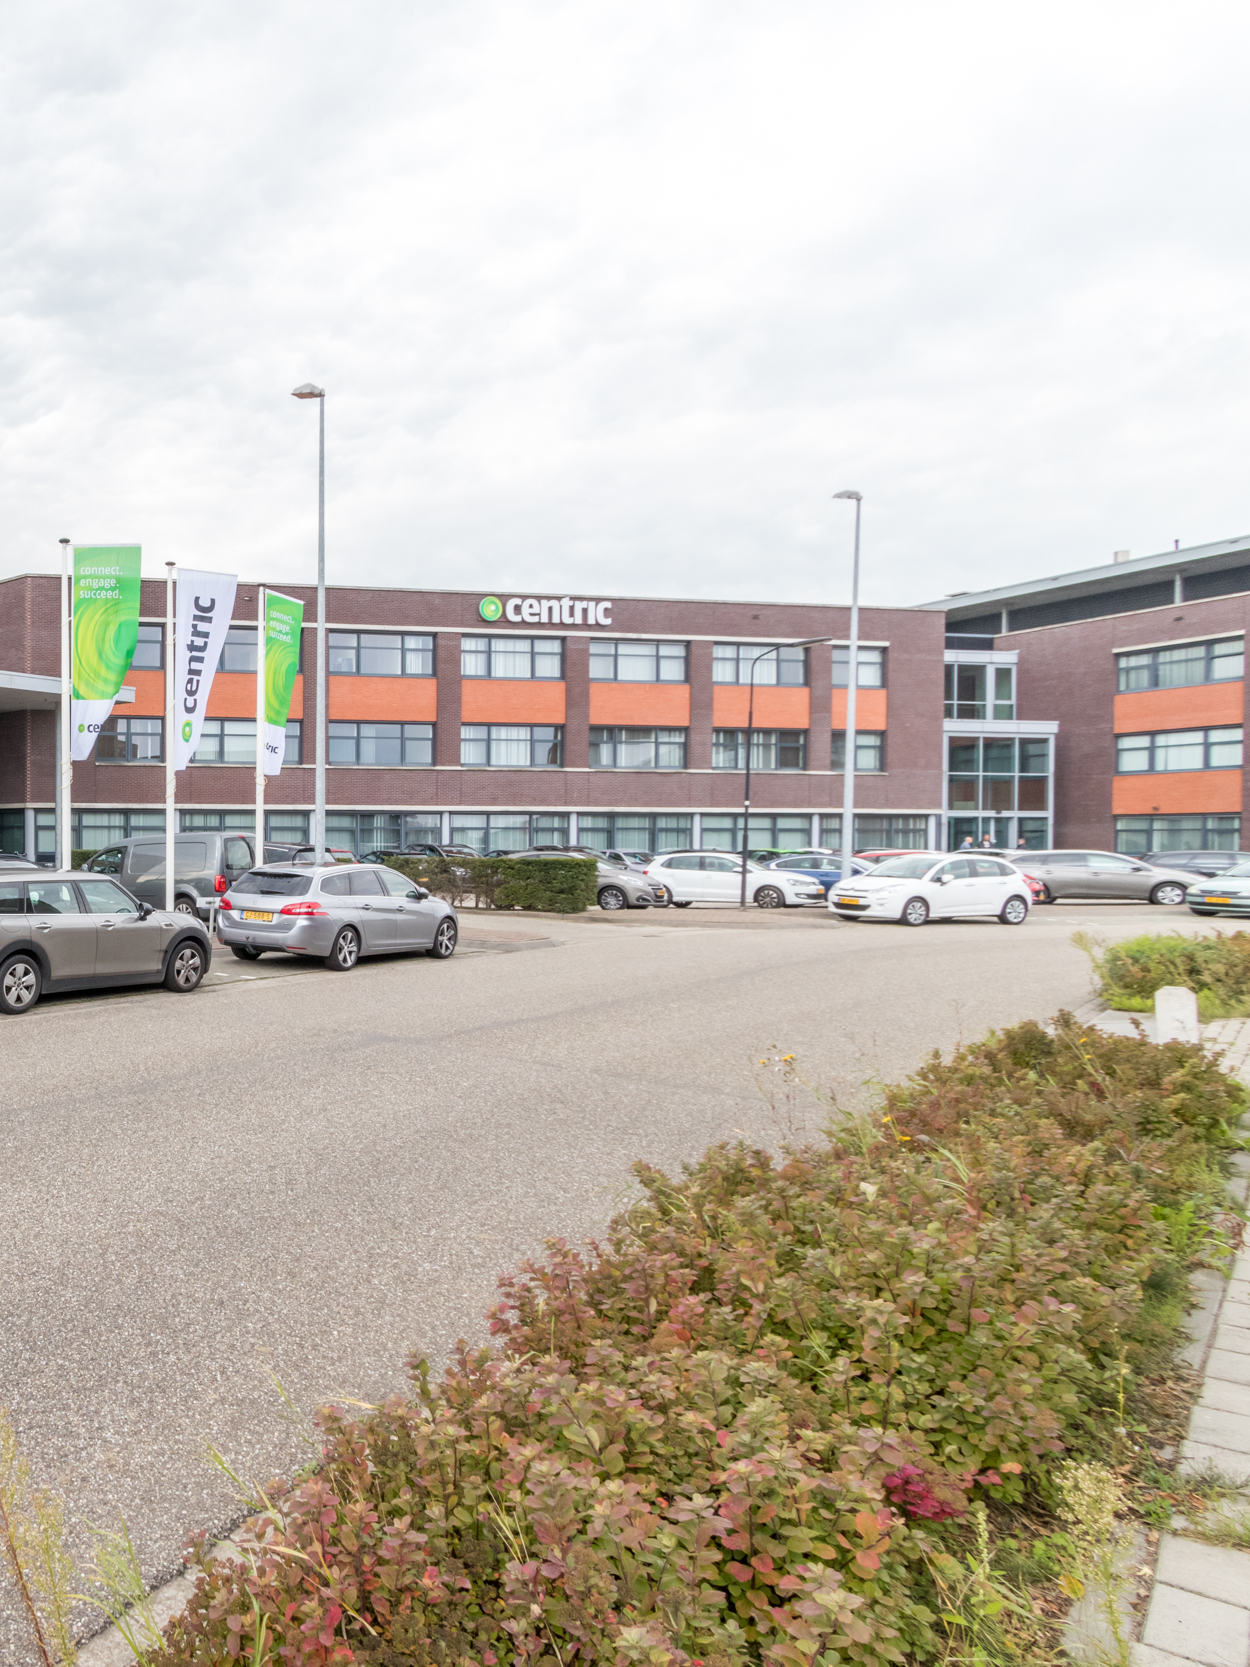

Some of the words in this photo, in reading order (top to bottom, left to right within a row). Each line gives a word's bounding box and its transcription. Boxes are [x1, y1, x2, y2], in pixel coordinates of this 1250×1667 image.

[80, 566, 123, 575] connect.
[80, 578, 119, 589] engage.
[80, 589, 122, 599] succeed.
[505, 596, 612, 625] centric
[270, 610, 294, 624] connect.
[269, 621, 291, 633] engage.
[269, 630, 293, 643] succeed.
[183, 596, 216, 714] centric
[87, 723, 103, 733] ce
